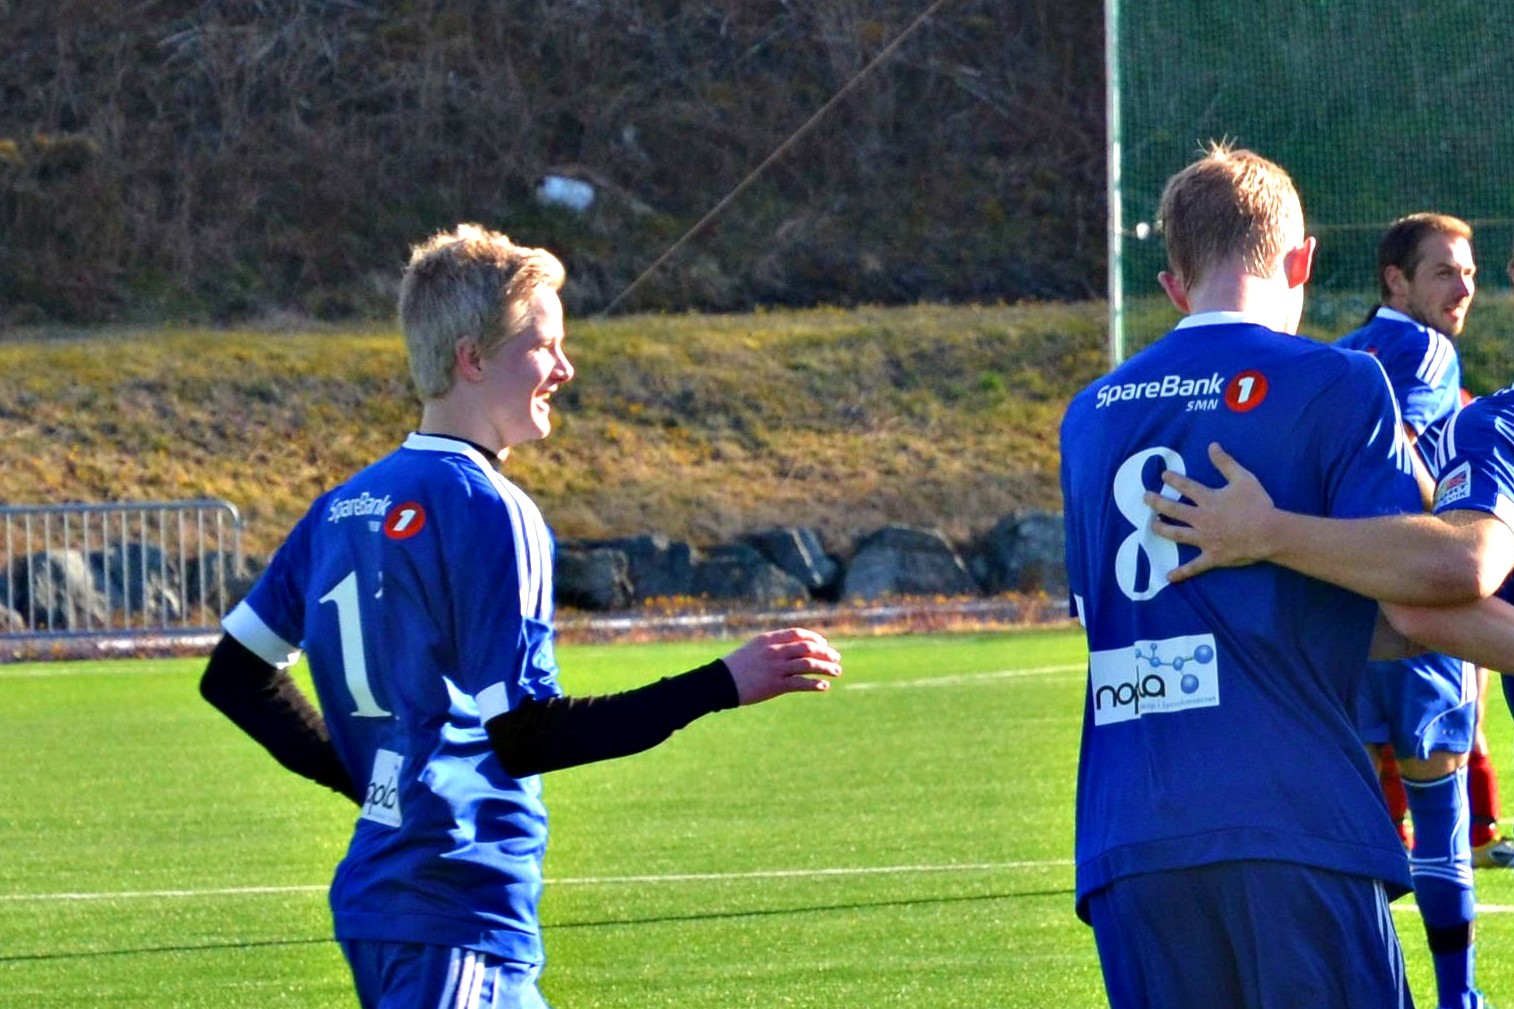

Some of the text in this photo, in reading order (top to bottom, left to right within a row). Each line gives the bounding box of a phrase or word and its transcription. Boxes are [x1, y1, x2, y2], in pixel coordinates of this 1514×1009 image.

[1096, 372, 1255, 409] SpareBank 1
[1185, 398, 1219, 412] SMN
[392, 509, 417, 532] 1
[1113, 446, 1187, 601] 8
[318, 571, 401, 720] 1
